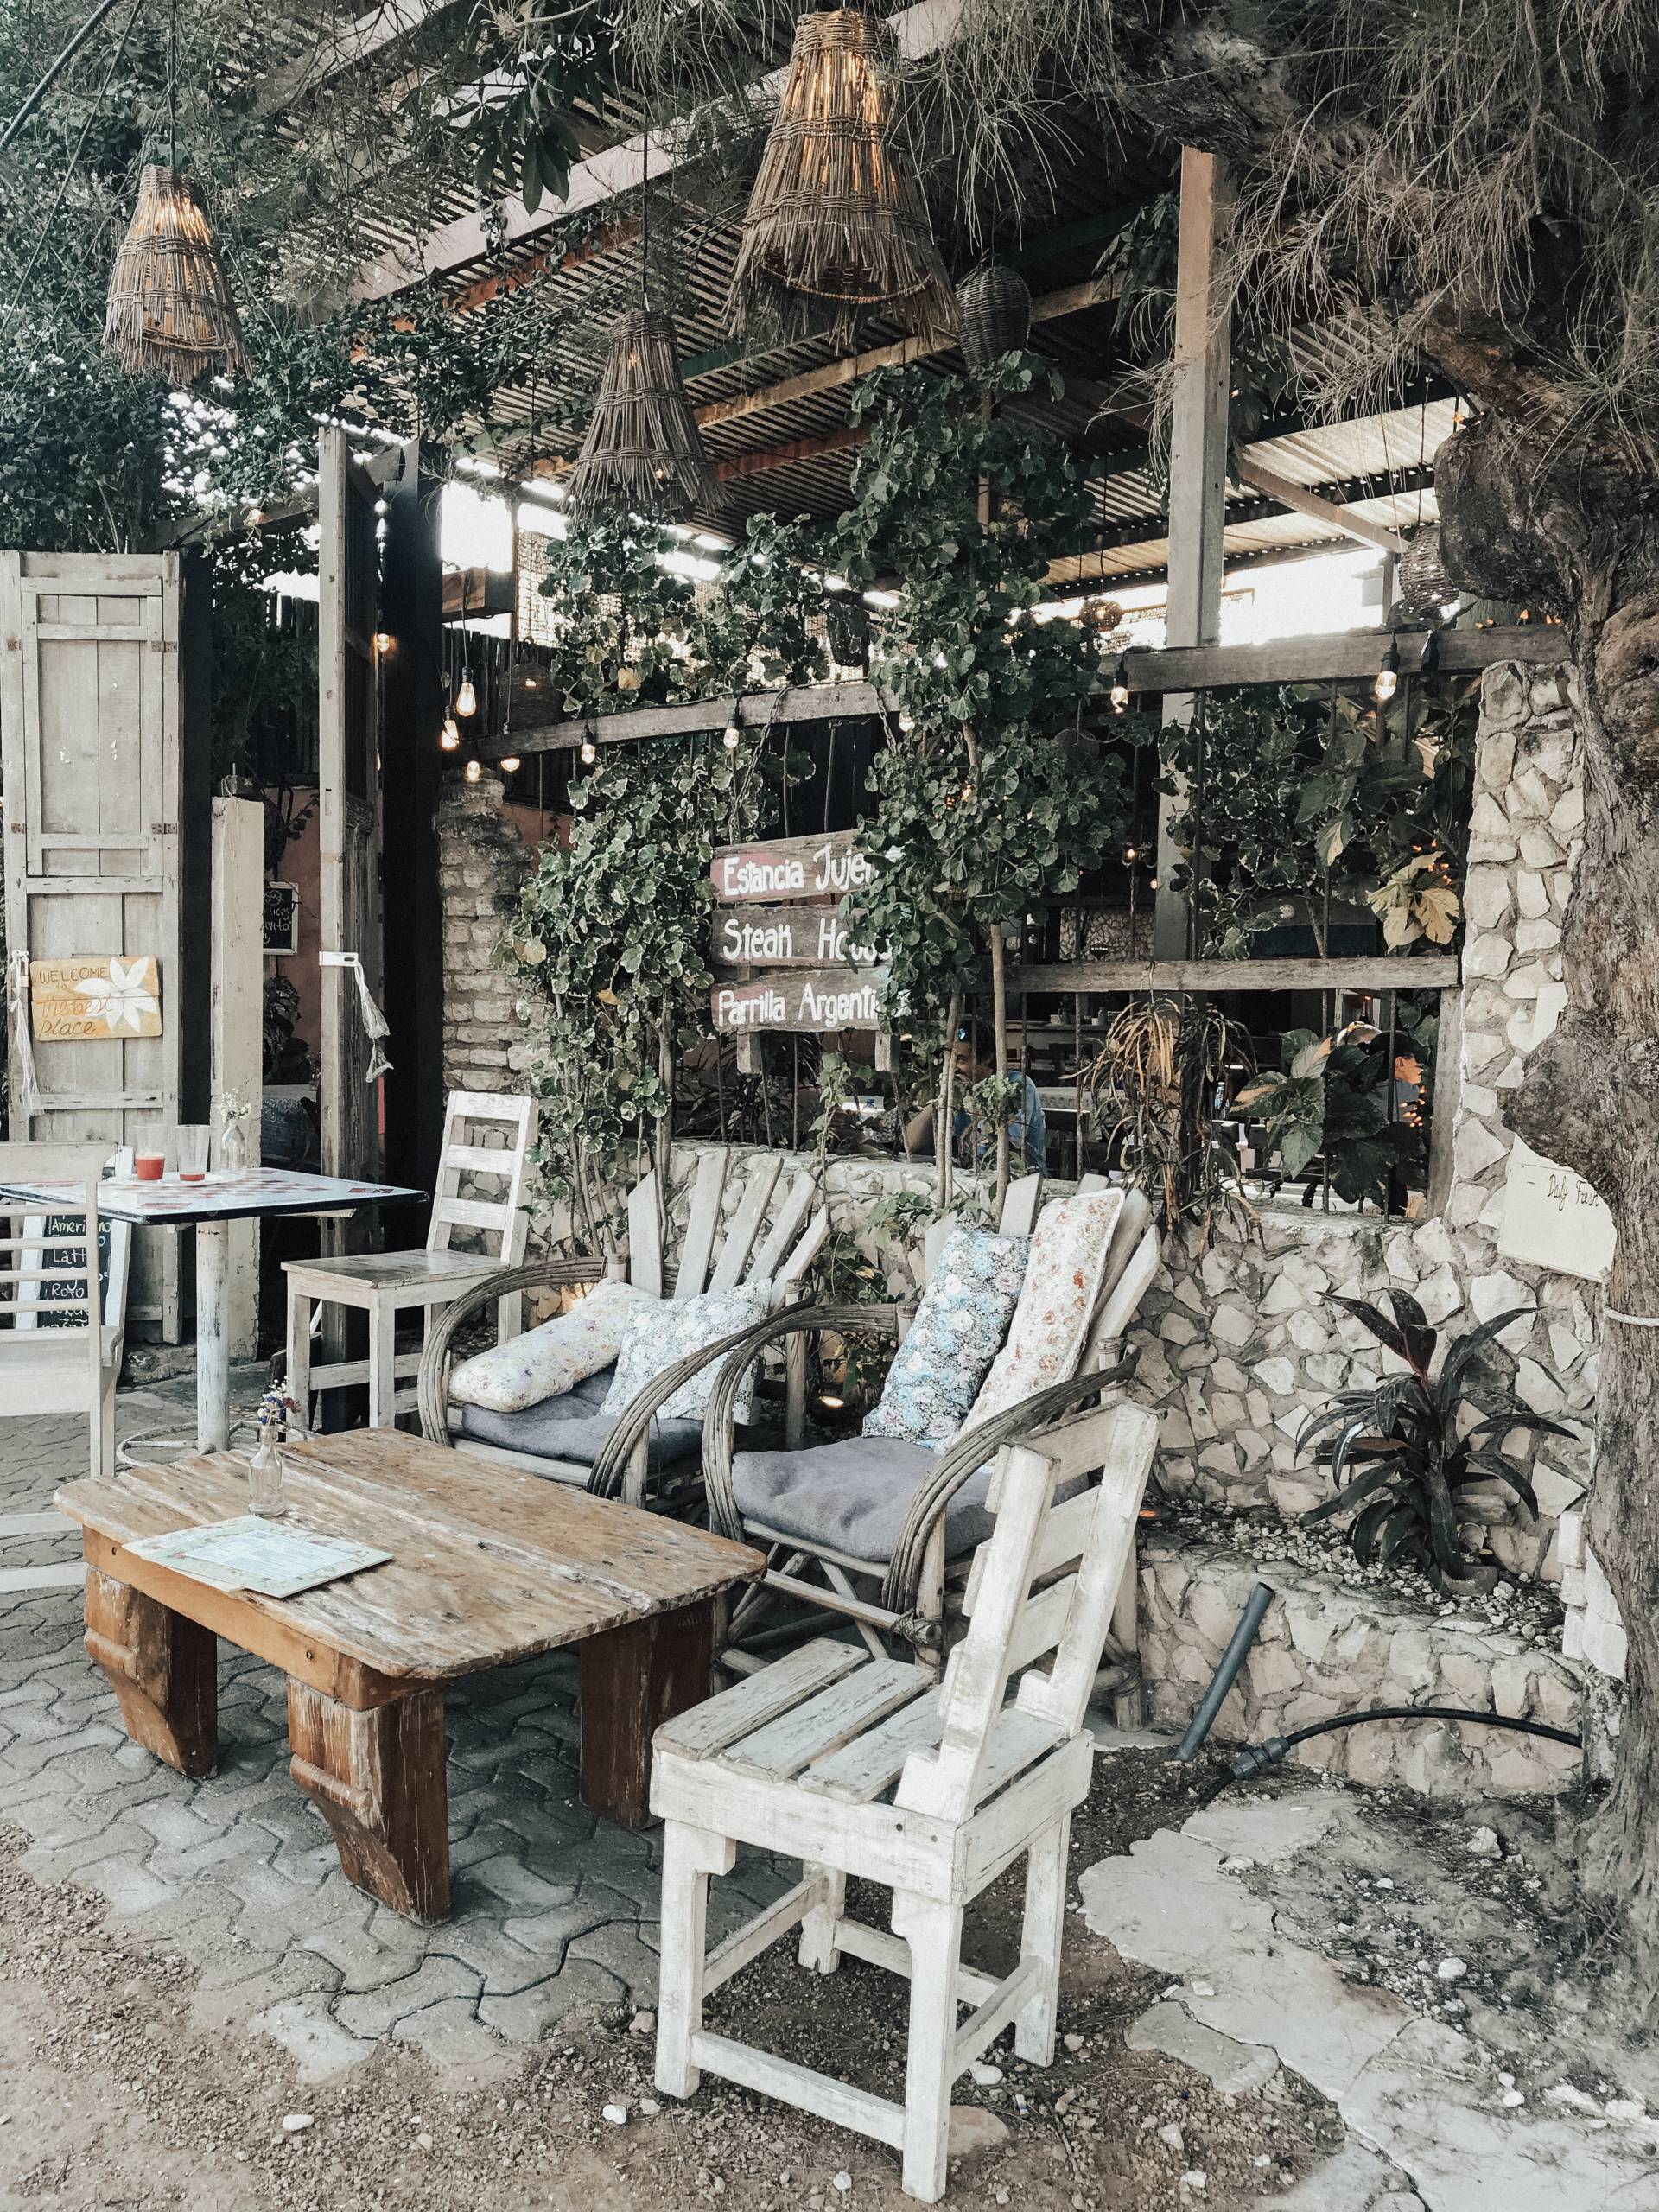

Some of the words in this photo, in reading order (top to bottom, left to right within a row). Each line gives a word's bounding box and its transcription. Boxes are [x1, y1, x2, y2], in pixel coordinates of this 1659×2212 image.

[723, 855, 804, 896] Estancia
[722, 918, 793, 960] Steak
[39, 966, 109, 984] WELCOME
[54, 982, 68, 991] to
[718, 989, 786, 1027] Parrilla
[798, 982, 879, 1028] Argenti
[38, 1018, 97, 1038] place
[1548, 1173, 1568, 1211] Daily
[51, 1218, 111, 1233] Amerino
[53, 1249, 86, 1264] Latt
